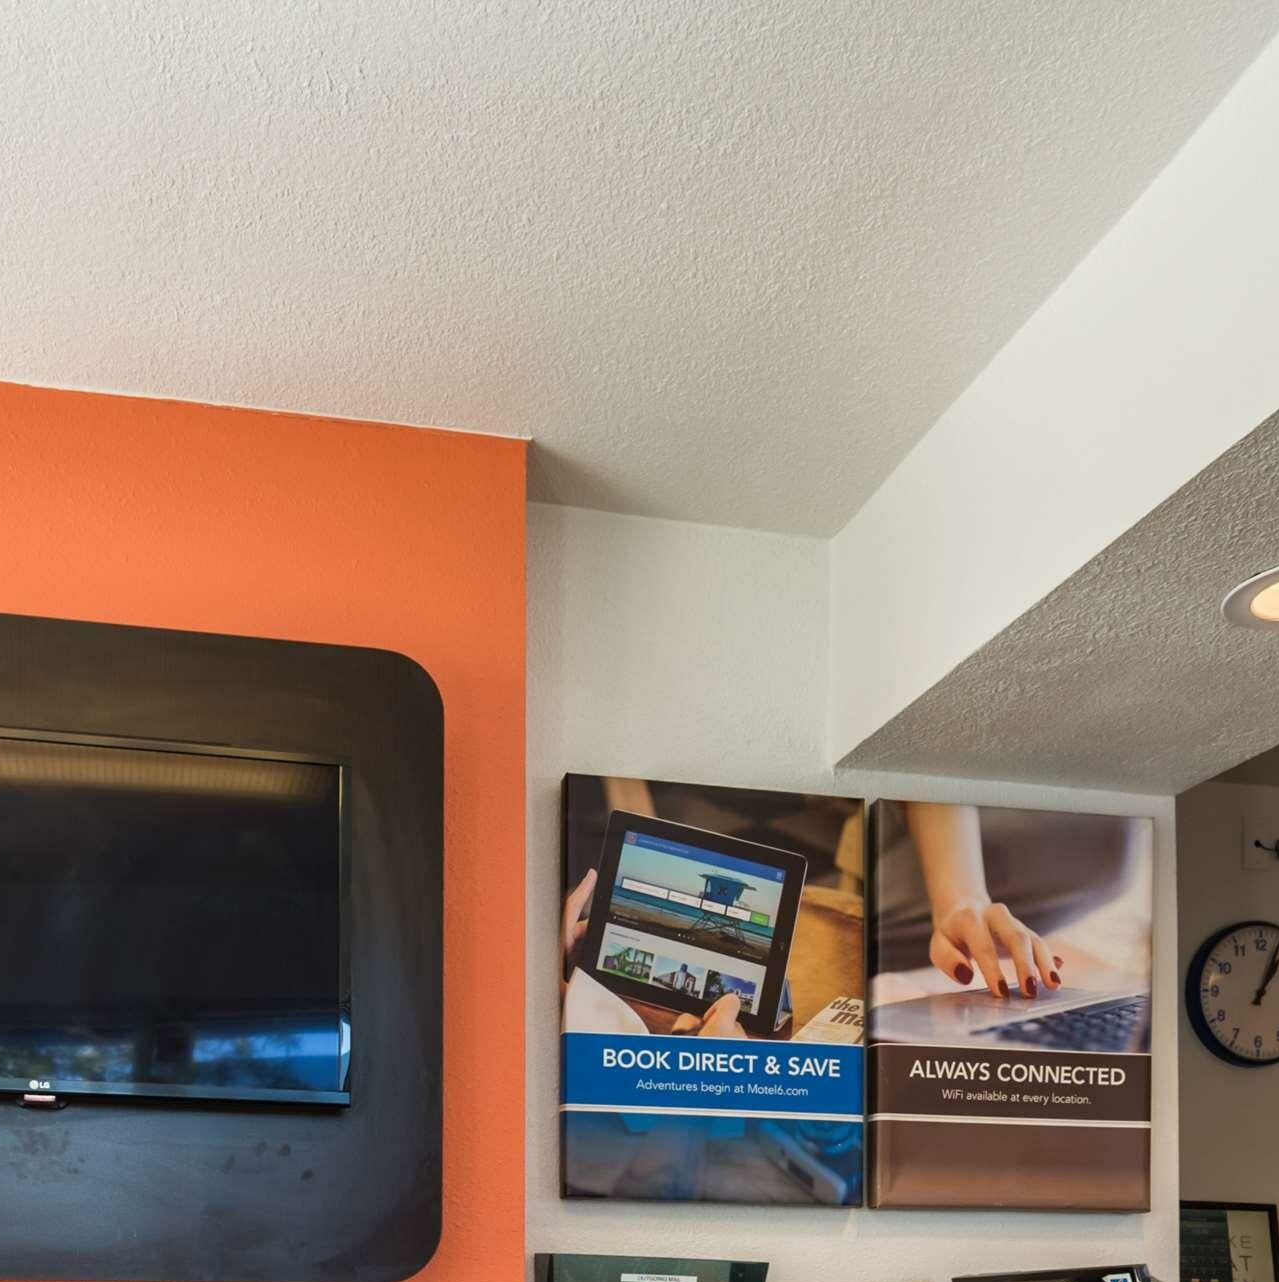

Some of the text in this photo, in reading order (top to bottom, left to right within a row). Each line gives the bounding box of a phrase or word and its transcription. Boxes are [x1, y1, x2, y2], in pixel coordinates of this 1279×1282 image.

[1234, 945, 1246, 957] 11
[1256, 940, 1267, 951] 12
[1210, 985, 1219, 997] 9
[1217, 1010, 1225, 1021] 8
[1232, 1028, 1239, 1039] 7
[1254, 1036, 1262, 1048] 6
[602, 1048, 841, 1078] BOOK DIRECT & SAVE
[909, 1059, 1126, 1086] ALWAYS CONNECTED
[636, 1079, 809, 1096] Adventures begin at Motel6.com
[941, 1088, 1091, 1106] WiFi available at every location.
